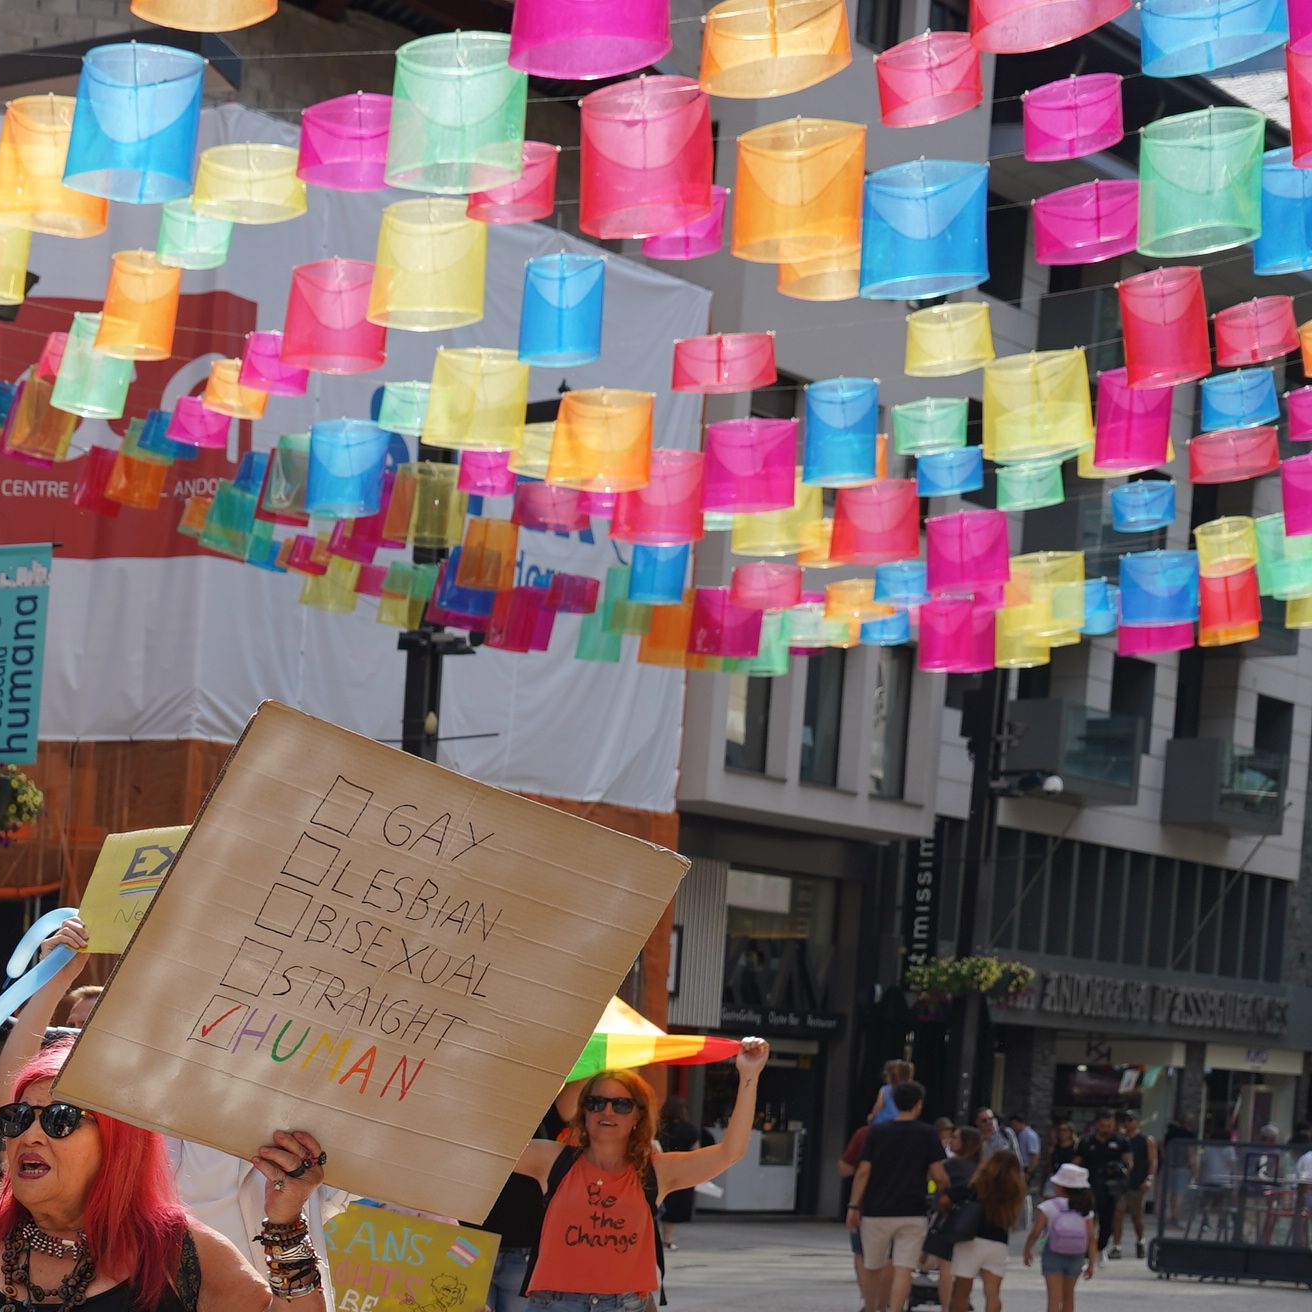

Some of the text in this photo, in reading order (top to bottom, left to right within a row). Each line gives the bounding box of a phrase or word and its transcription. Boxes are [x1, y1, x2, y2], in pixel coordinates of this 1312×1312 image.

[0, 479, 69, 498] CENTRE
[382, 804, 495, 861] GAY
[332, 860, 503, 942] LESBIAN
[304, 904, 491, 998] BISEXUAL
[272, 965, 469, 1050] STRAIGHT
[231, 1008, 426, 1102] HUMAN
[586, 1182, 619, 1209] Be
[589, 1211, 626, 1230] the
[564, 1225, 639, 1254] Change
